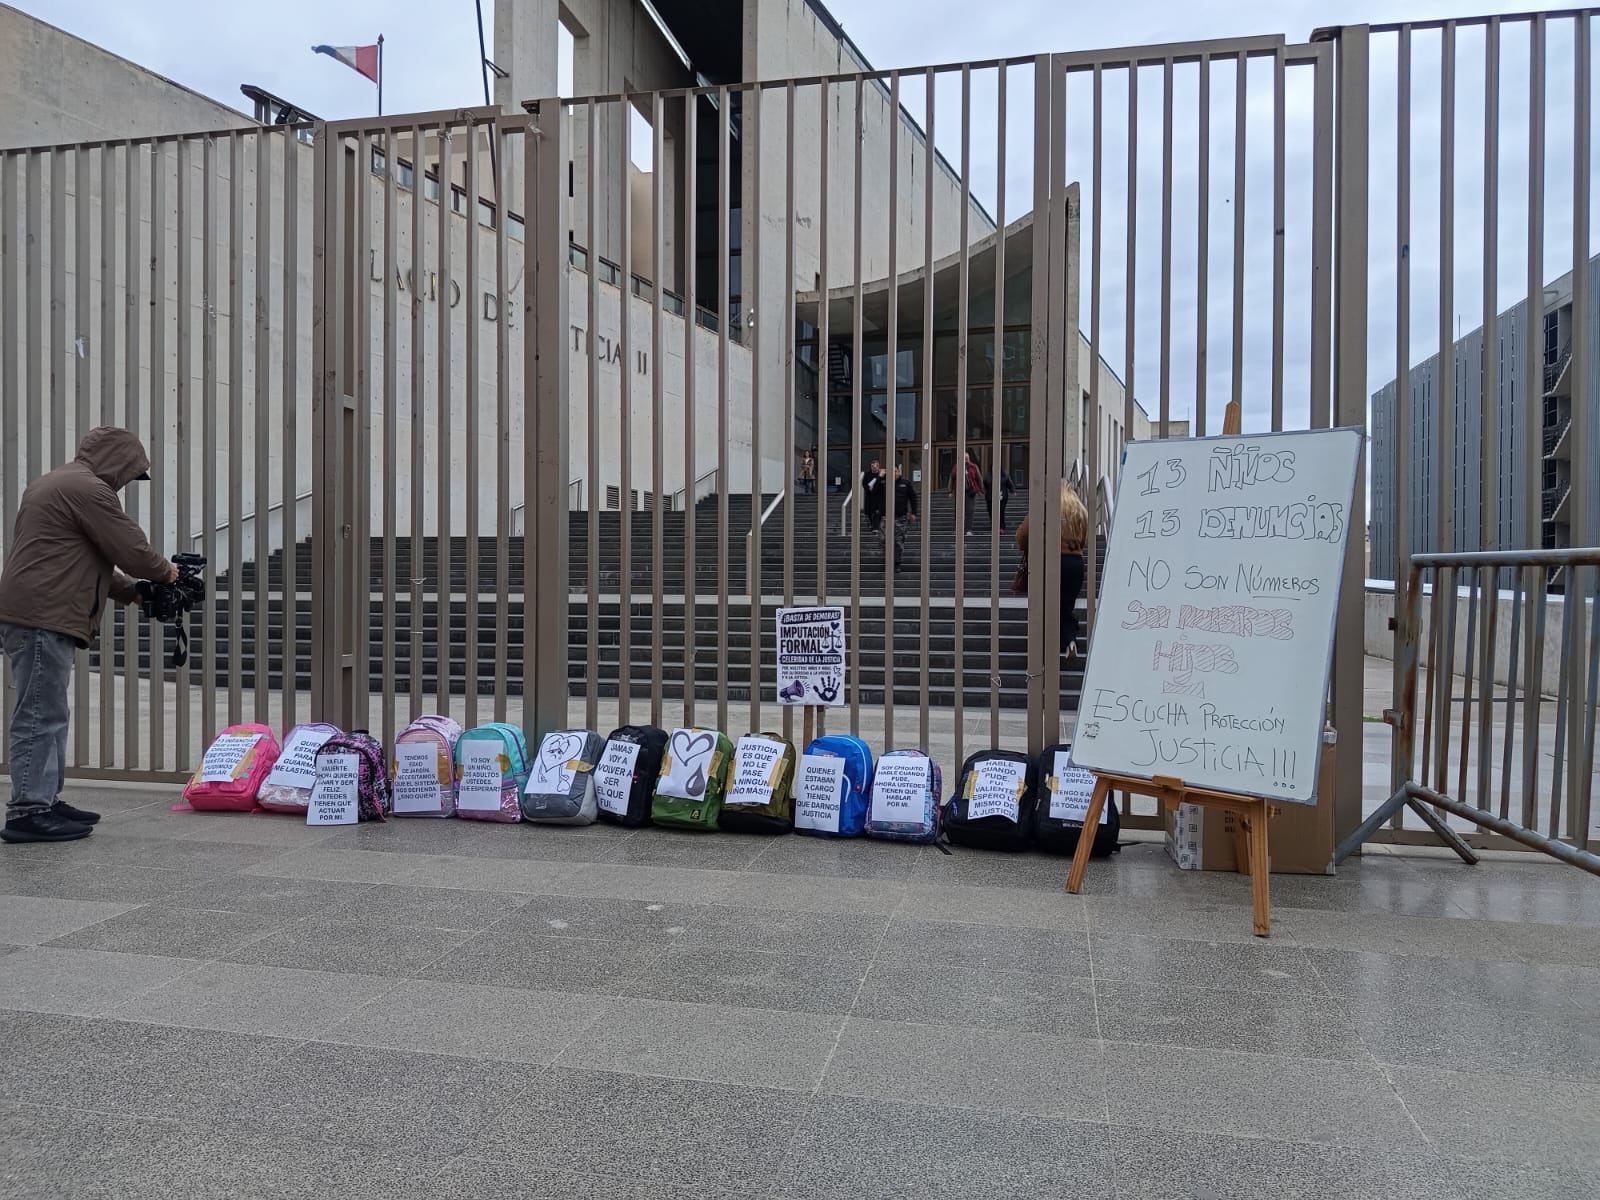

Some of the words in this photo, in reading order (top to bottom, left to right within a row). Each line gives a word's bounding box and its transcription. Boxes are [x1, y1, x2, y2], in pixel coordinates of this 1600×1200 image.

[1136, 458, 1187, 496] 13
[1134, 508, 1181, 540] 13
[1198, 494, 1344, 544] DENUNCIAS
[1128, 556, 1171, 593] NO
[805, 613, 812, 621] DE
[780, 624, 830, 639] IMPUTACIÓN
[780, 639, 823, 654] FORMAL
[1092, 688, 1189, 726] ESCUCHA
[1199, 702, 1286, 735] PROTECCIÓN
[741, 744, 778, 755] JUSTICIA
[294, 753, 312, 761] PARA
[609, 754, 622, 763] VOY
[622, 757, 628, 765] A
[754, 753, 773, 762] QUE
[756, 761, 768, 769] LE
[598, 763, 626, 777] VOLVER
[626, 769, 633, 778] A
[742, 769, 764, 777] PASE
[806, 766, 836, 776] QUIENES
[981, 766, 1017, 775] CUANDO
[603, 777, 620, 787] SER
[805, 775, 835, 784] ESTABAN
[597, 785, 605, 795] EL
[606, 789, 624, 799] QUE
[810, 784, 835, 793] CARGO
[807, 793, 831, 801] TIENEN
[797, 800, 810, 808] QUE
[811, 801, 839, 811] DARNOS
[974, 800, 1002, 808] MISMO
[1003, 801, 1015, 810] DE
[801, 810, 832, 819] JUSTICIA
[968, 810, 979, 818] LA
